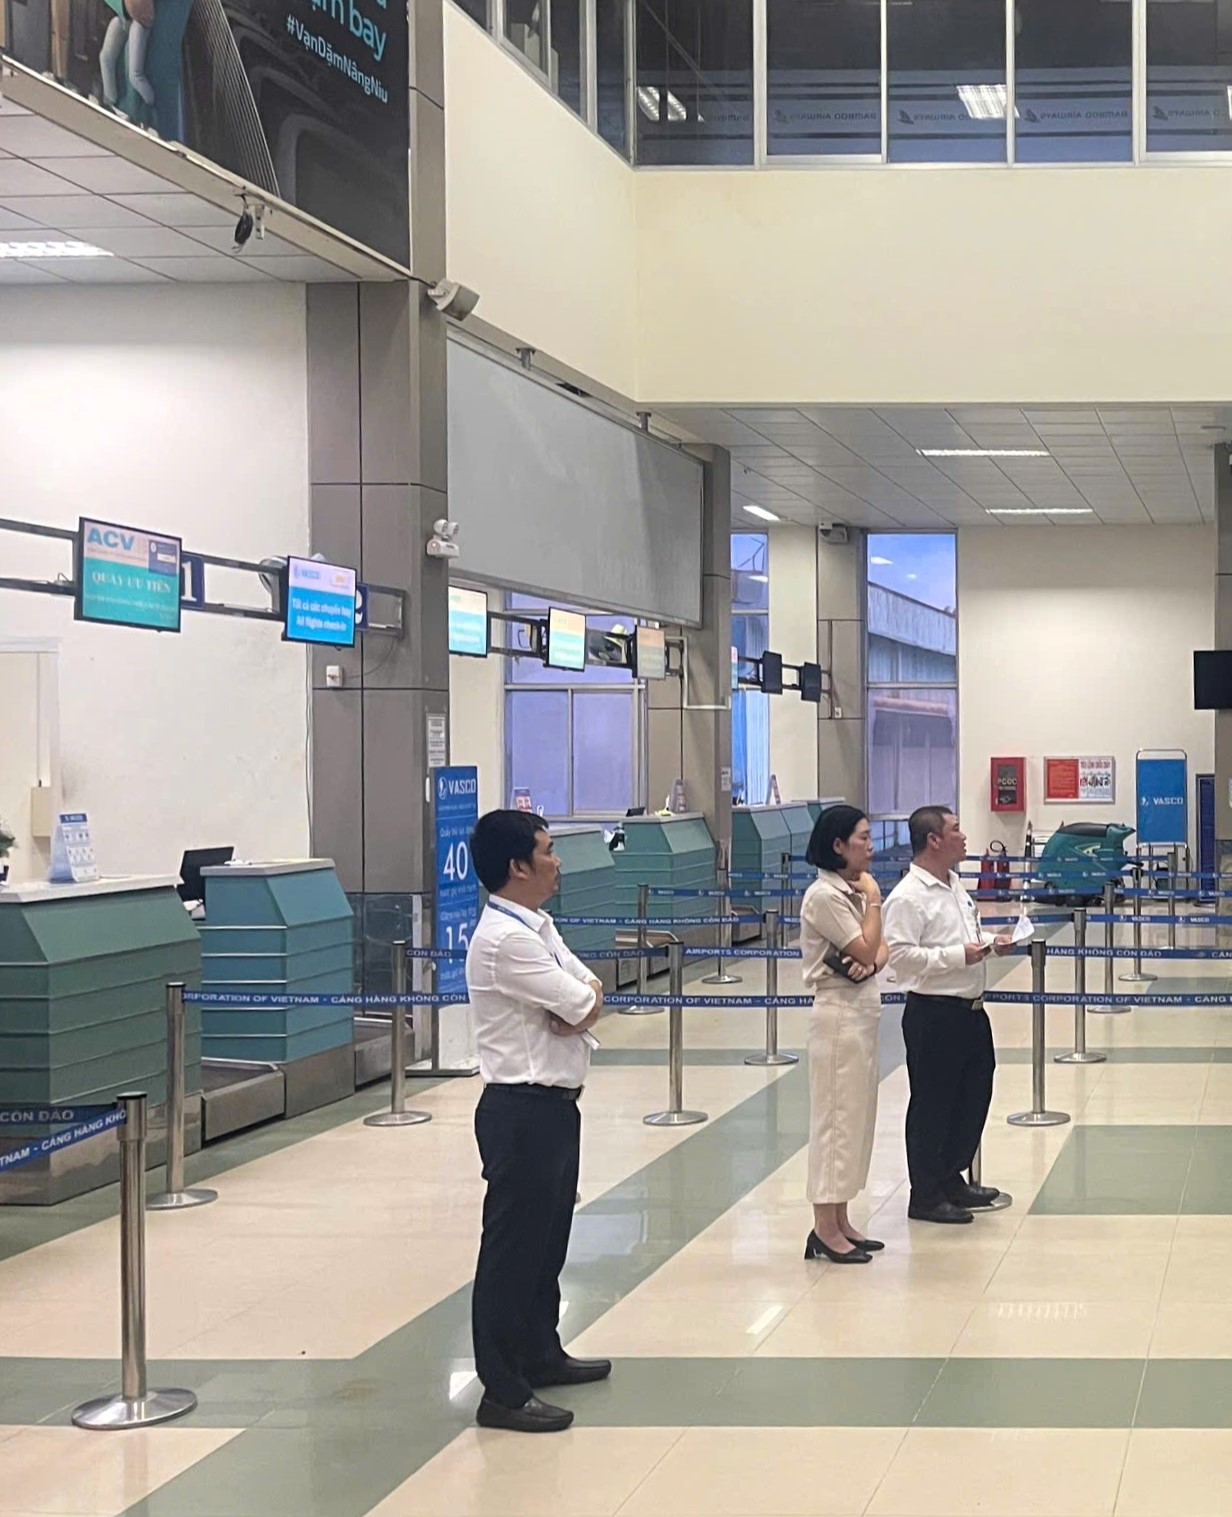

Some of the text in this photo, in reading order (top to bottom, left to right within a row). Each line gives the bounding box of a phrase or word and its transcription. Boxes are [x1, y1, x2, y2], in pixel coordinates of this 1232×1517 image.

[87, 527, 136, 552] ACV
[181, 561, 198, 602] 1
[448, 779, 477, 795] VASCO
[1153, 797, 1184, 805] VASCO
[442, 841, 468, 881] 40
[685, 948, 800, 958] AIRPORTS CORPORATION
[253, 994, 268, 1002] OF
[270, 995, 318, 1003] VIETNAM
[604, 996, 683, 1004] CORPORATION
[686, 996, 701, 1004] OF
[704, 997, 753, 1005] VIETNAM
[1033, 995, 1112, 1004] CORPORATION
[1134, 996, 1183, 1004] VIETNAM
